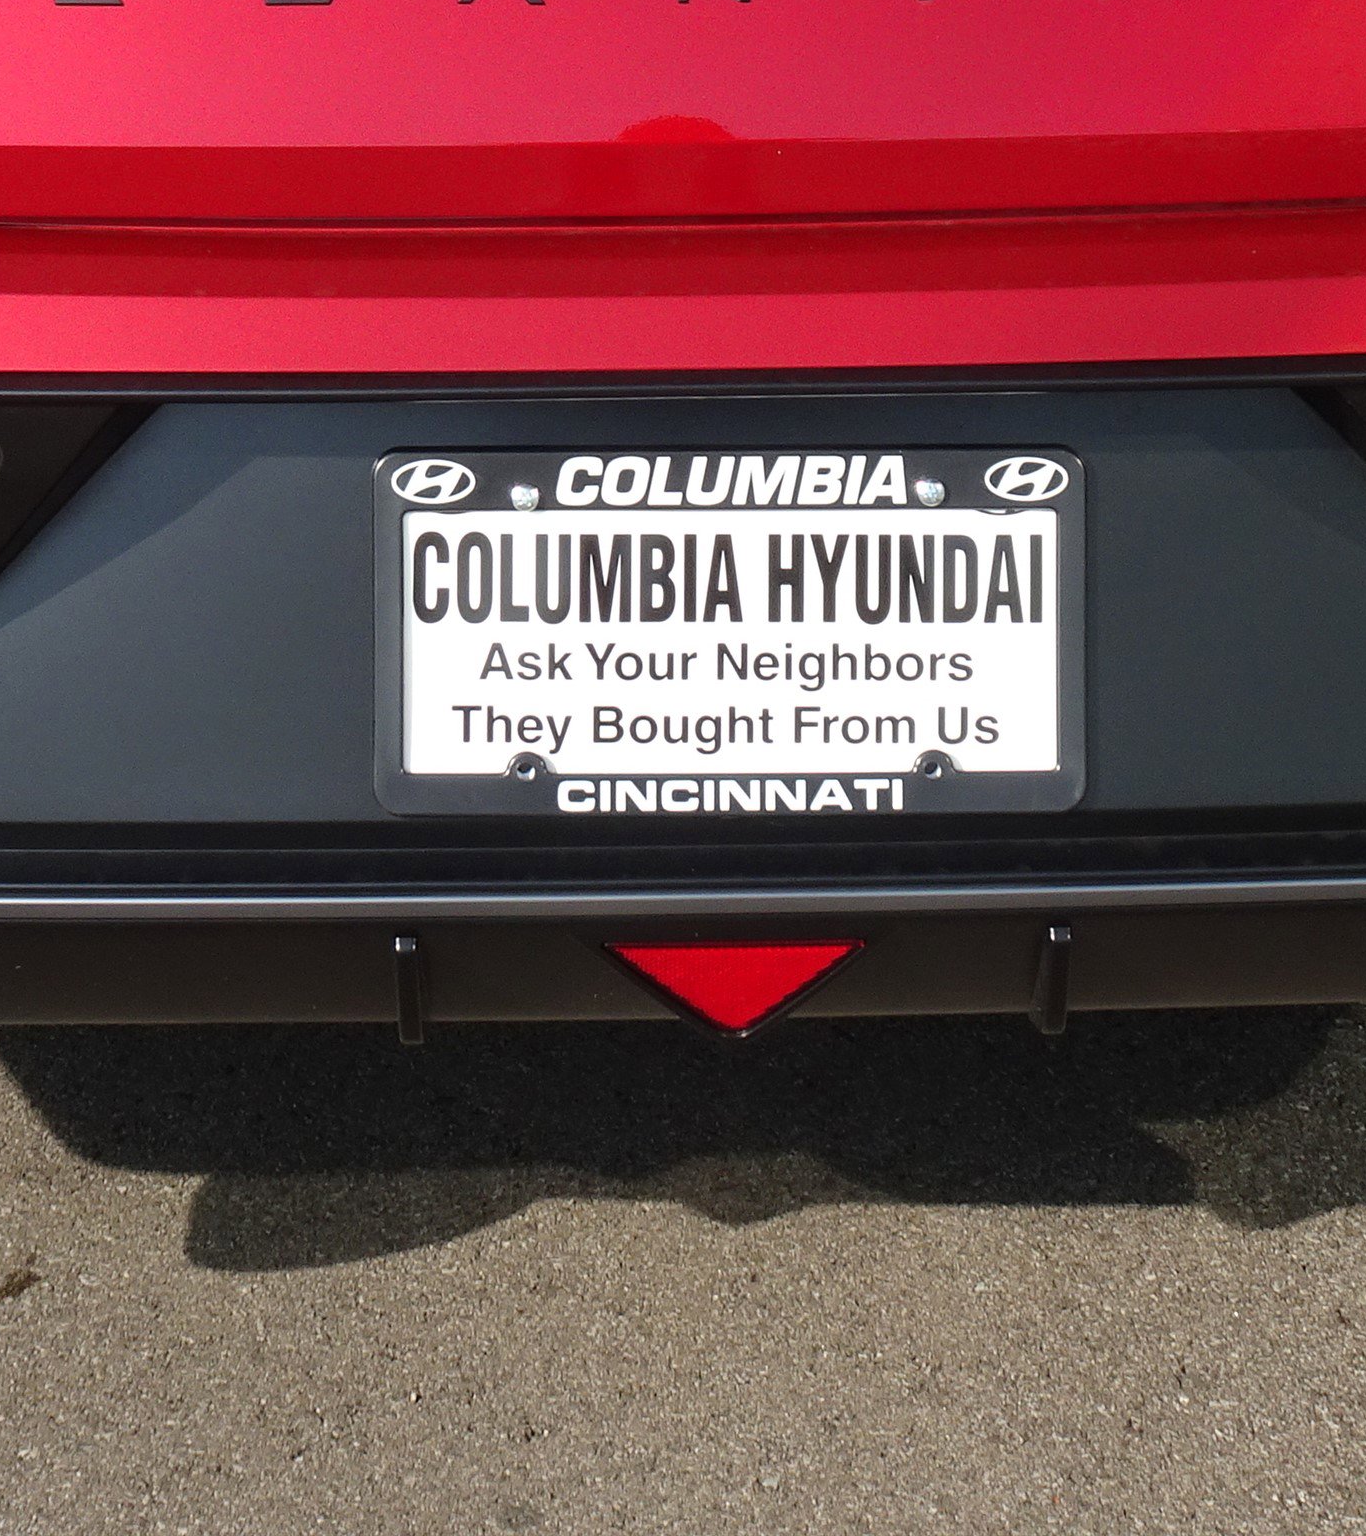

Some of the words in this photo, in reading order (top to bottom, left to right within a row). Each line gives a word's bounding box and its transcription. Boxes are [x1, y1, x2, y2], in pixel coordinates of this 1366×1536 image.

[555, 454, 908, 507] COLUMBIA
[412, 531, 744, 625] COLUMBIA
[767, 533, 1044, 625] HYUNDAI
[479, 642, 573, 681] Ask
[584, 642, 698, 682] Your
[716, 642, 974, 692] Neighbors
[451, 705, 573, 755] They
[592, 705, 774, 755] Bought
[793, 706, 916, 744] From
[937, 706, 1000, 745] Us
[556, 778, 904, 813] CINCINNATI
